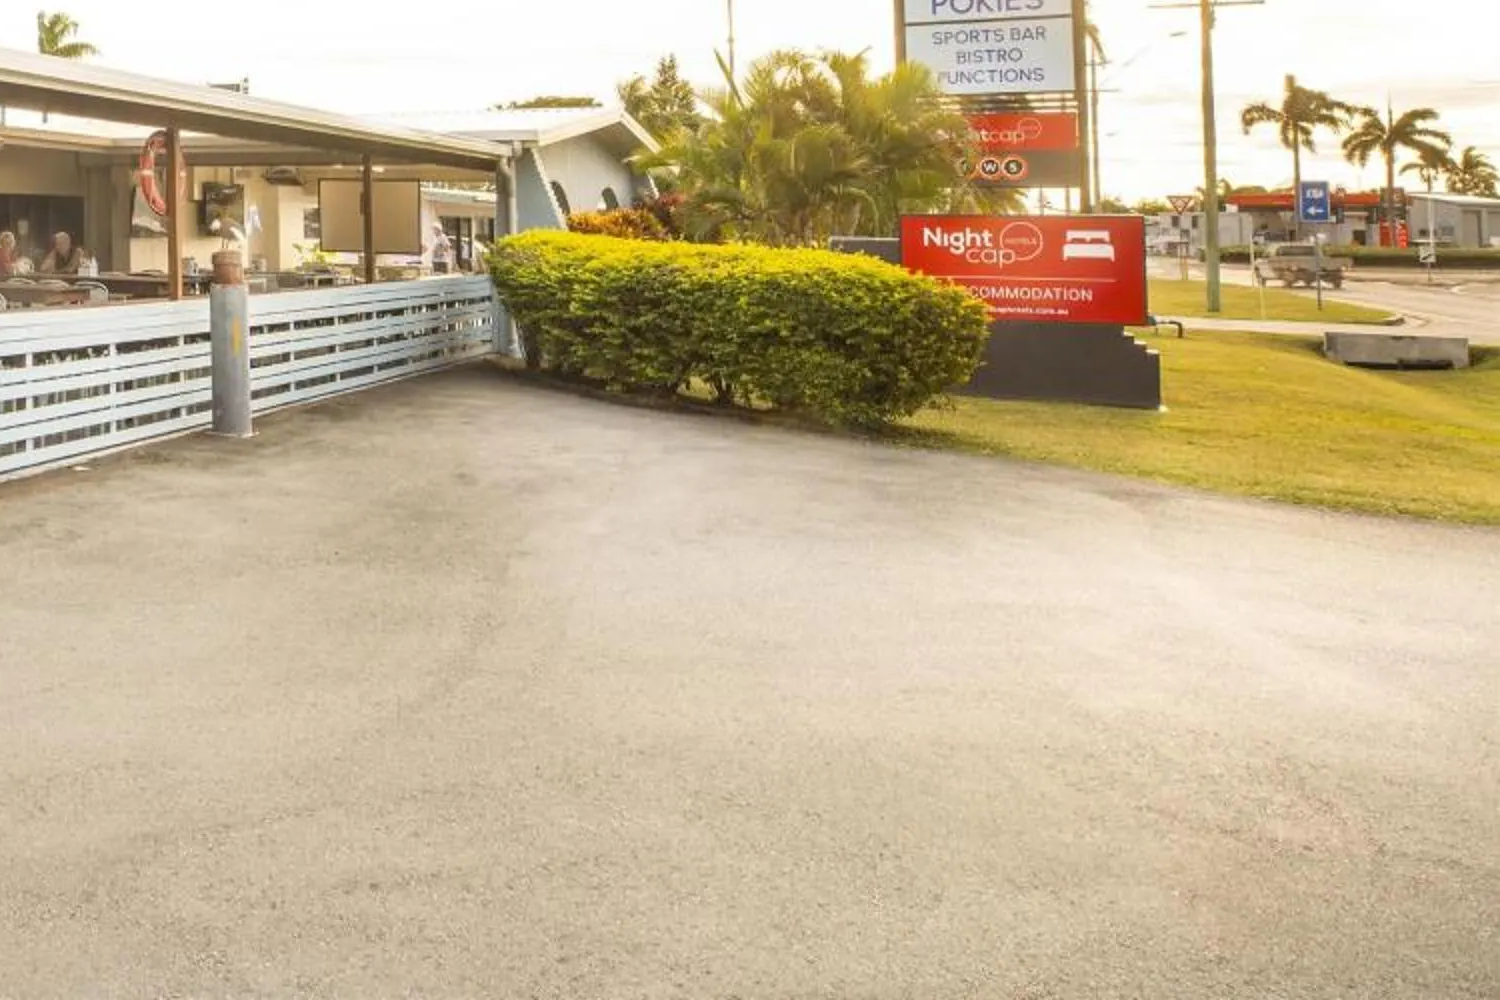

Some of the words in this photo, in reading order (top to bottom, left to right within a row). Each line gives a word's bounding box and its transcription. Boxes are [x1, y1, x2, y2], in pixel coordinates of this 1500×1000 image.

[931, 29, 1005, 46] SPORTS
[1008, 25, 1048, 41] BAR
[955, 47, 1024, 65] BISTRO
[937, 67, 1046, 86] FUNCTIONS
[922, 226, 993, 255] Night
[965, 248, 1016, 269] cap
[969, 286, 1094, 302] COMMODATION
